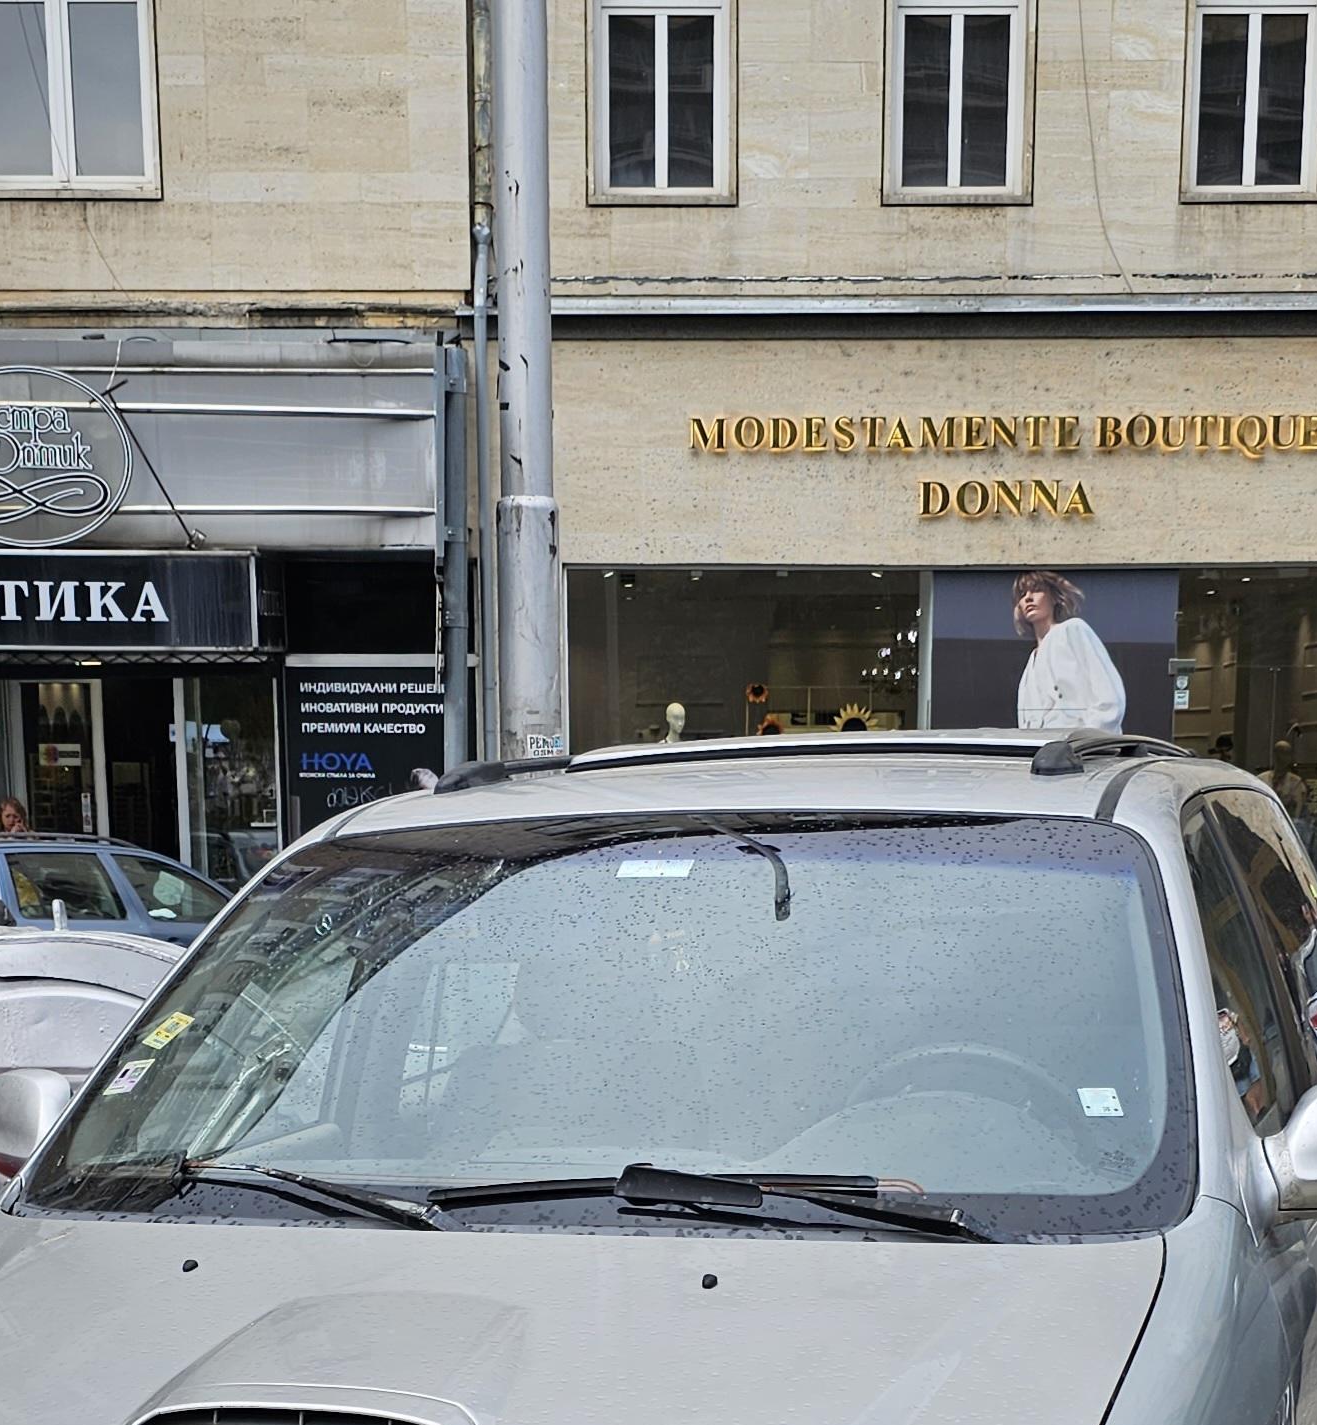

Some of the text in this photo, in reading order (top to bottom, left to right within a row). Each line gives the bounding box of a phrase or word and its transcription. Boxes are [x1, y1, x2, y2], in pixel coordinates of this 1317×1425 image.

[689, 415, 1083, 452] MODESTAMENTE
[918, 480, 1095, 517] DONNA
[299, 682, 398, 694] ИНДИВИДУАЛНИ
[300, 703, 445, 715] ИНОВАТИВНИ ПРОДУКТИ
[302, 723, 426, 734] ПРЕМИУМ КАЧЕСТВО
[300, 753, 373, 771] HOYA
